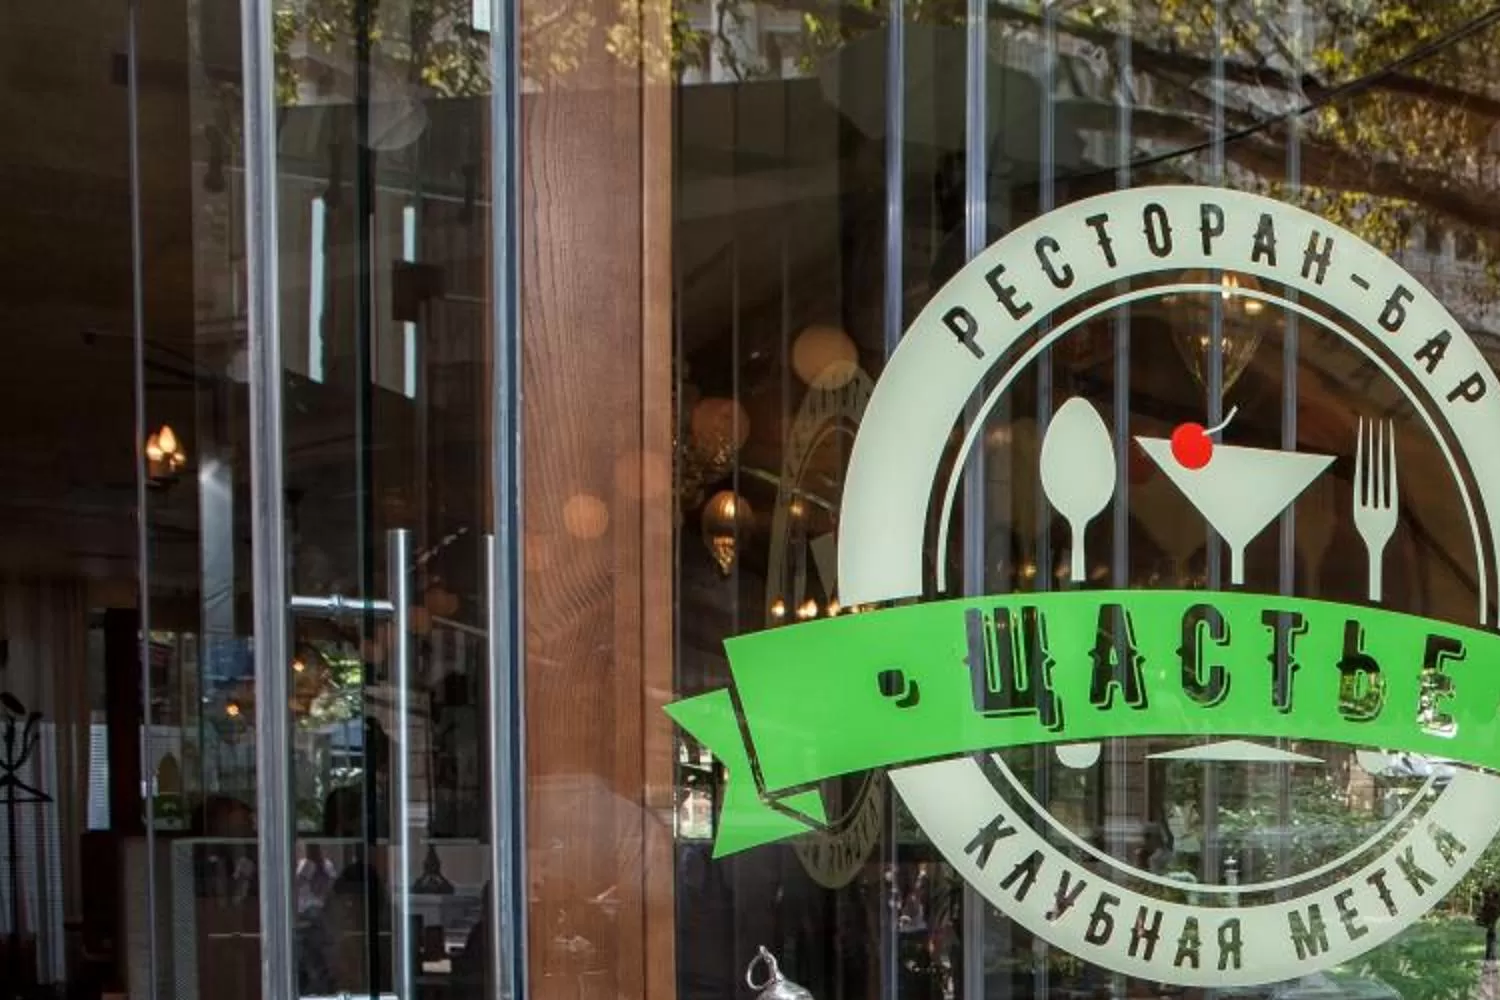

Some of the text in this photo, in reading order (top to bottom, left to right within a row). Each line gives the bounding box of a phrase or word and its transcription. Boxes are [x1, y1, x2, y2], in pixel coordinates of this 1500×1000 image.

[941, 202, 1487, 405] РЕСТОРАН-БАР
[962, 603, 1467, 737] ЩАСТЬЕ
[963, 814, 1468, 971] КЛУБНАЯ МЕТКА
